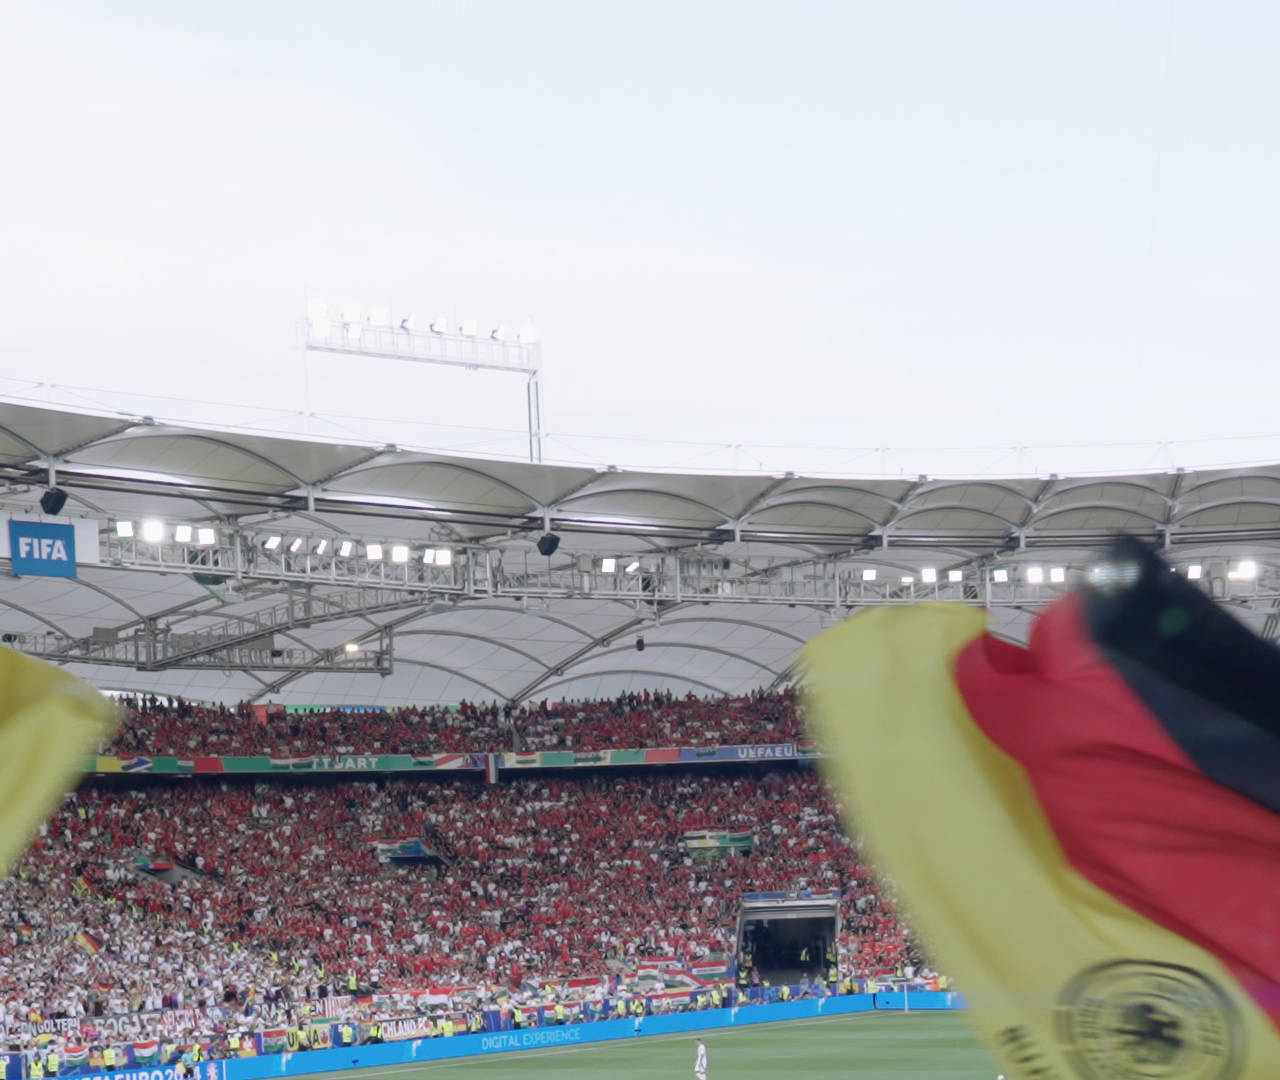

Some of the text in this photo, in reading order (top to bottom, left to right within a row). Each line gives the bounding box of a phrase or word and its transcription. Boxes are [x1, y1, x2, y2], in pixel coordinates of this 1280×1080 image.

[18, 536, 68, 561] FIFA
[481, 1028, 581, 1050] DIGITAL EXPERIENCE
